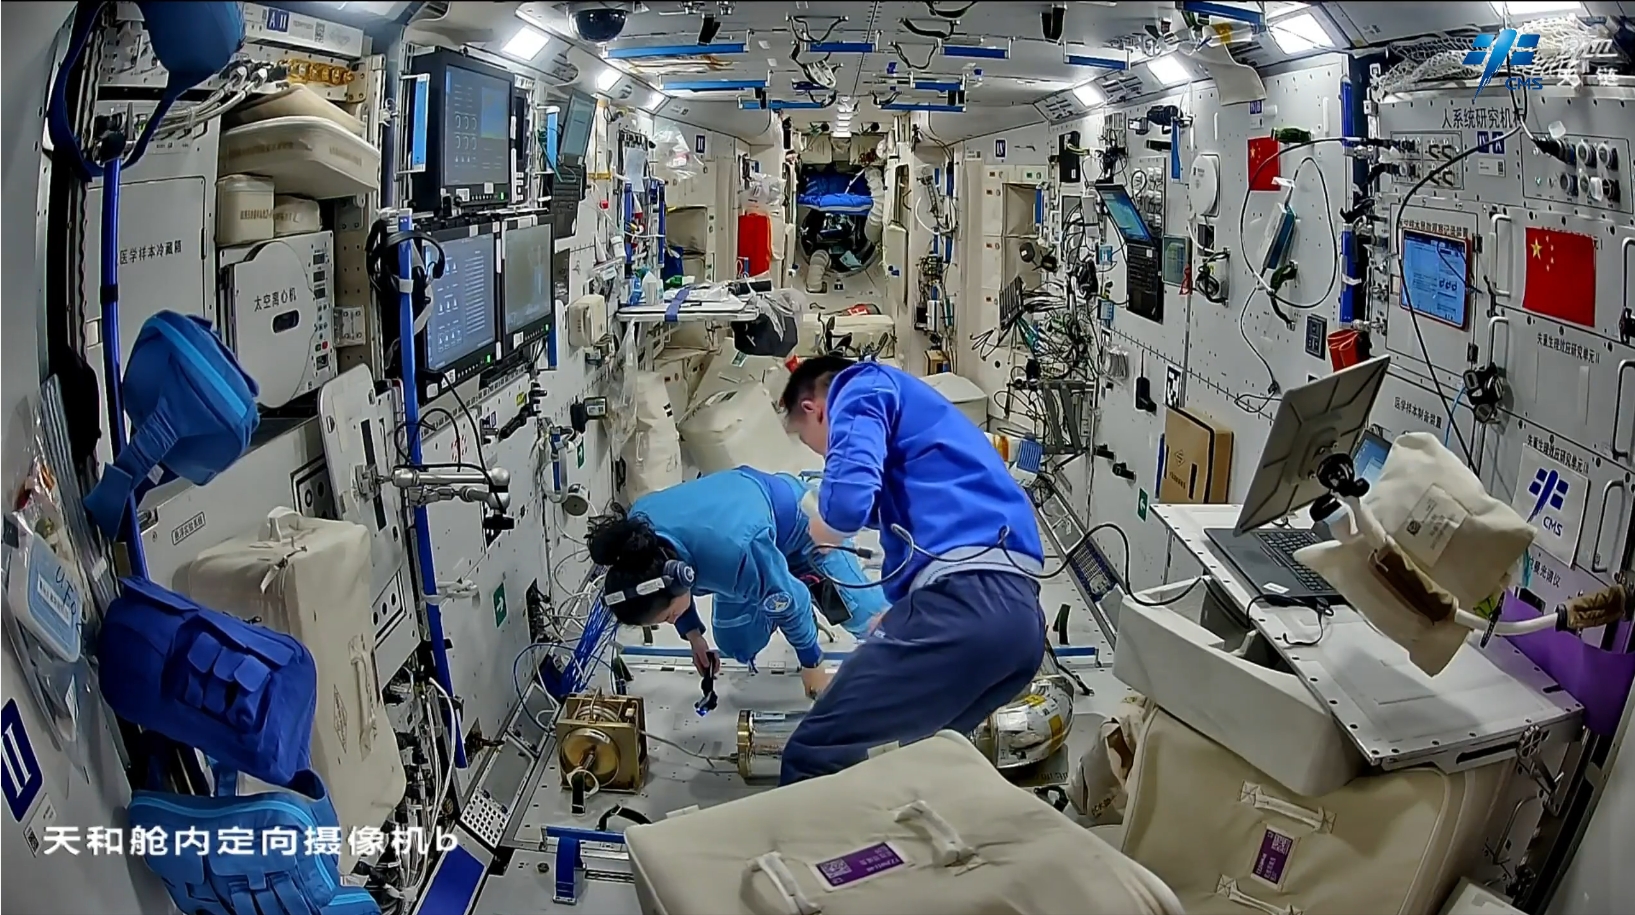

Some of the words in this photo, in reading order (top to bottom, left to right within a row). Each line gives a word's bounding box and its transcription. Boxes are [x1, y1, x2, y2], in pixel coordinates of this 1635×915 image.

[269, 12, 276, 28] A
[119, 239, 182, 265] 医学样本冷藏箱
[254, 287, 297, 312] 太空离心机
[1543, 516, 1563, 537] CMS
